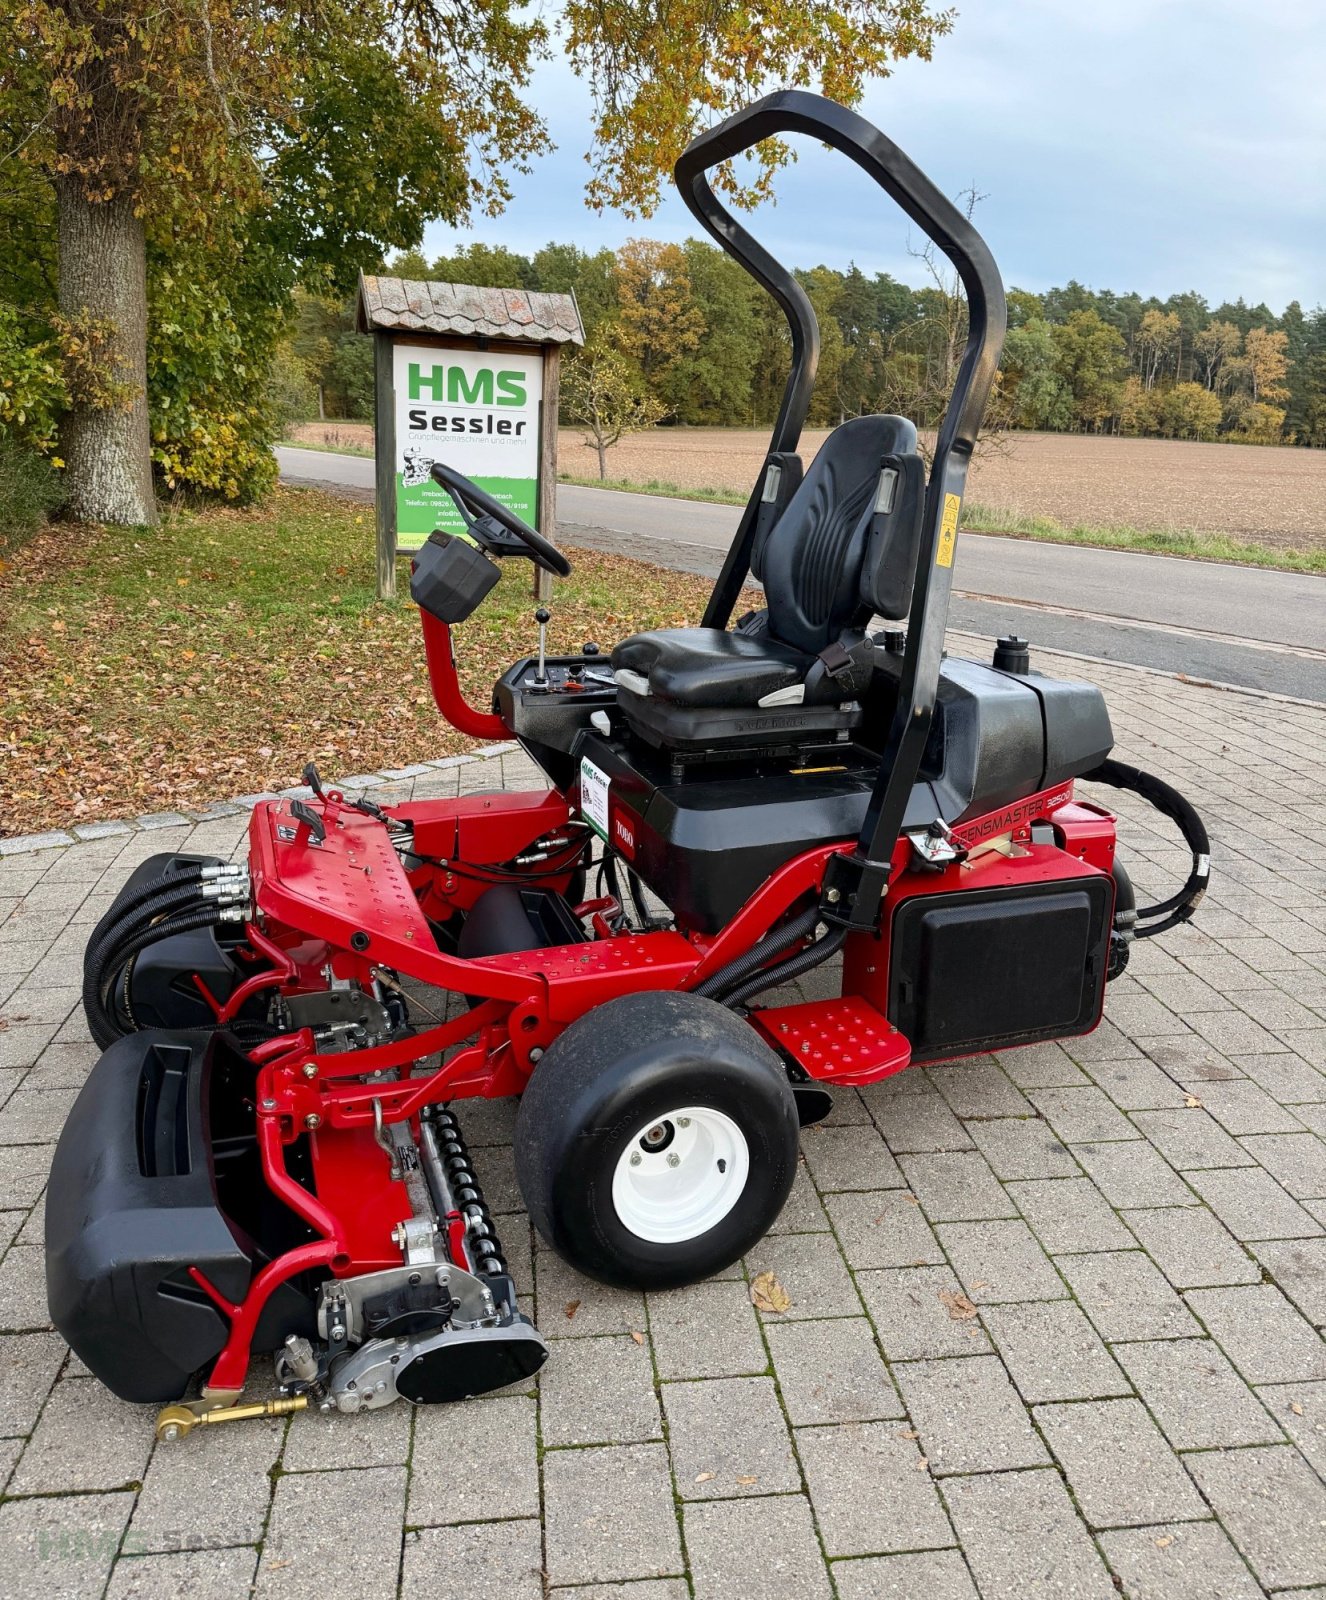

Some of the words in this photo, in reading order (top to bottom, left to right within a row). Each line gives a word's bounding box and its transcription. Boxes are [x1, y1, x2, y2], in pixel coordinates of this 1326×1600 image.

[408, 362, 527, 407] HMS
[408, 409, 527, 436] Sessler
[491, 436, 505, 445] und
[581, 761, 594, 780] HMS
[615, 819, 634, 848] TORO
[950, 799, 1044, 846] REENSMASTER
